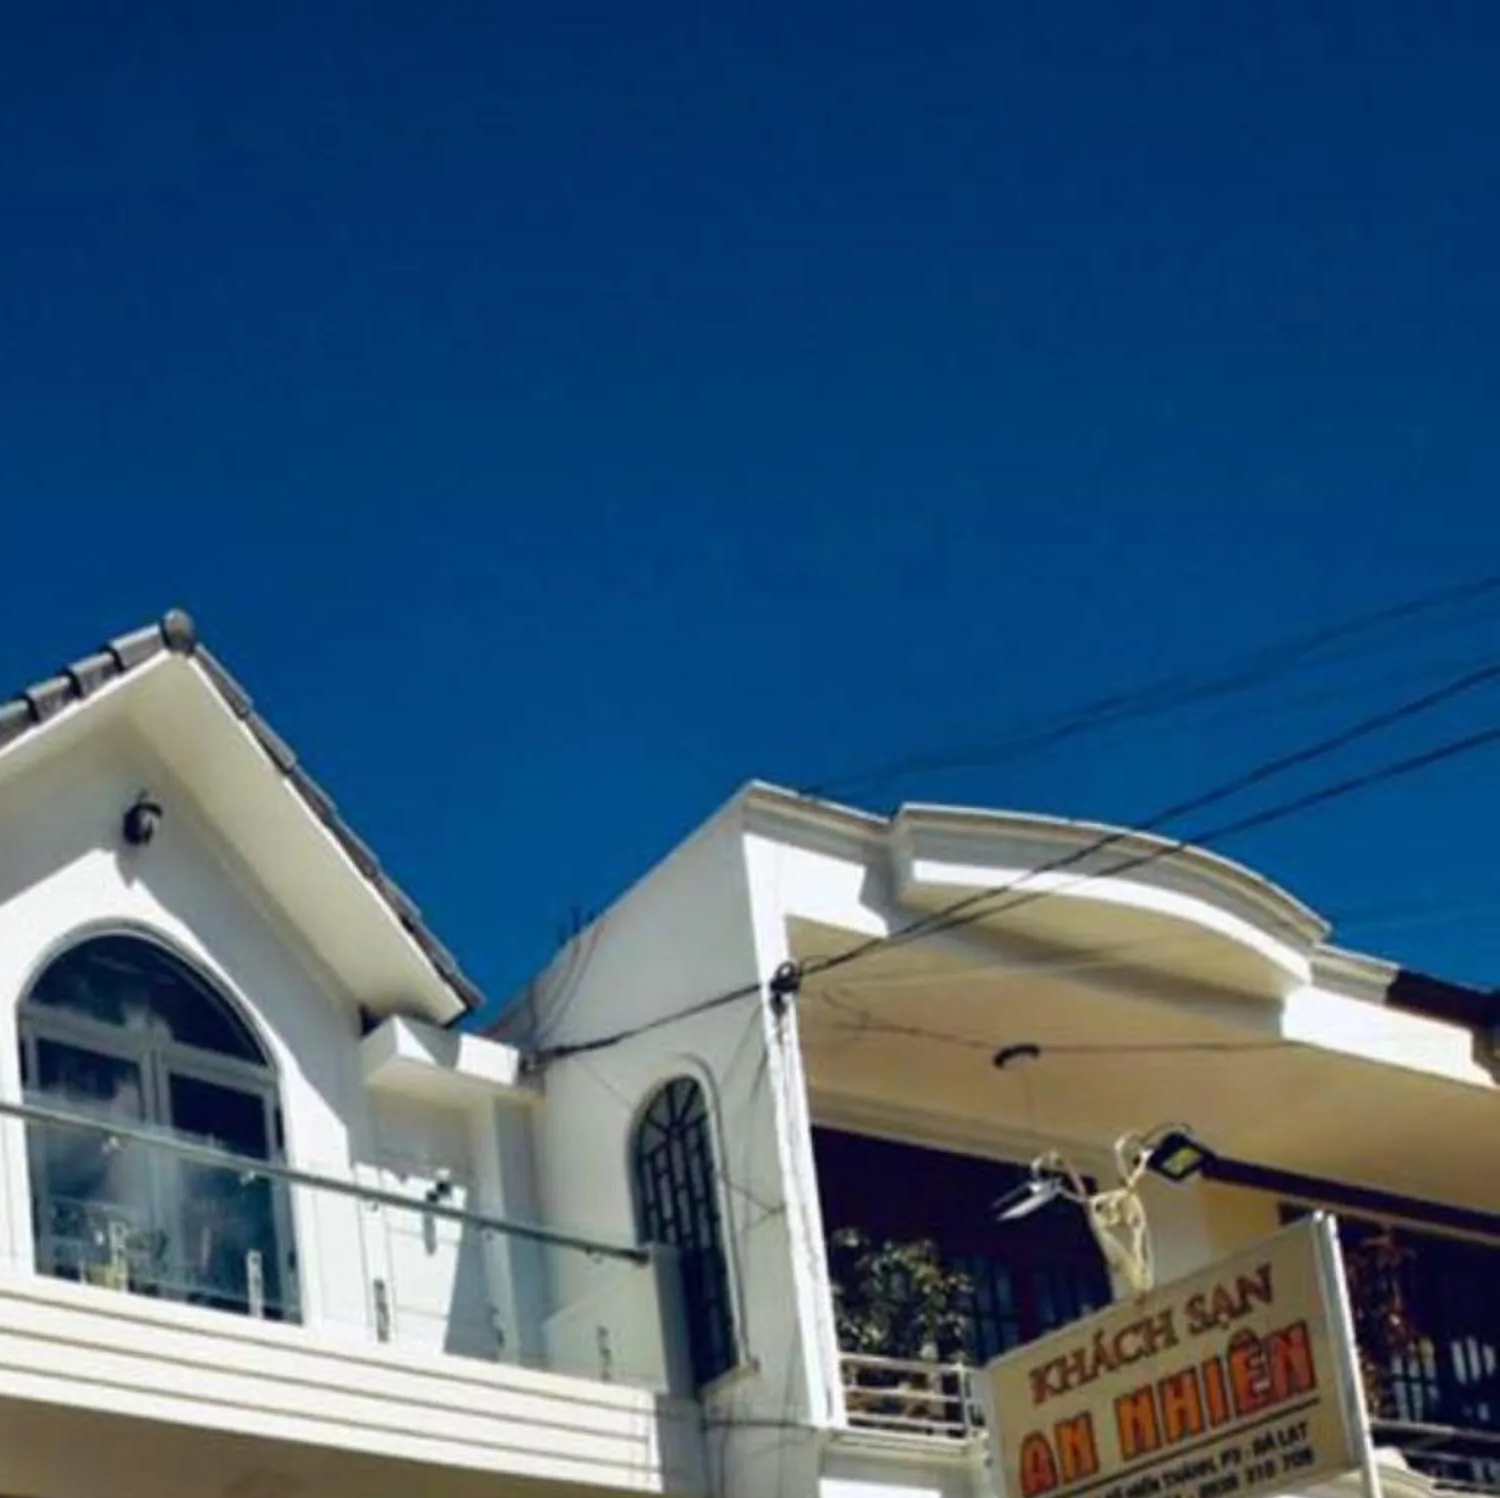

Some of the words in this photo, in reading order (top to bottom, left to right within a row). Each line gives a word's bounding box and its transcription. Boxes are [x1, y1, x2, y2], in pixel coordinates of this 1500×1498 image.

[1019, 1409, 1100, 1498] AN
[1113, 1321, 1318, 1463] NHIÊN
[1029, 1309, 1179, 1406] KHÁCH
[1184, 1263, 1273, 1336] SẠN
